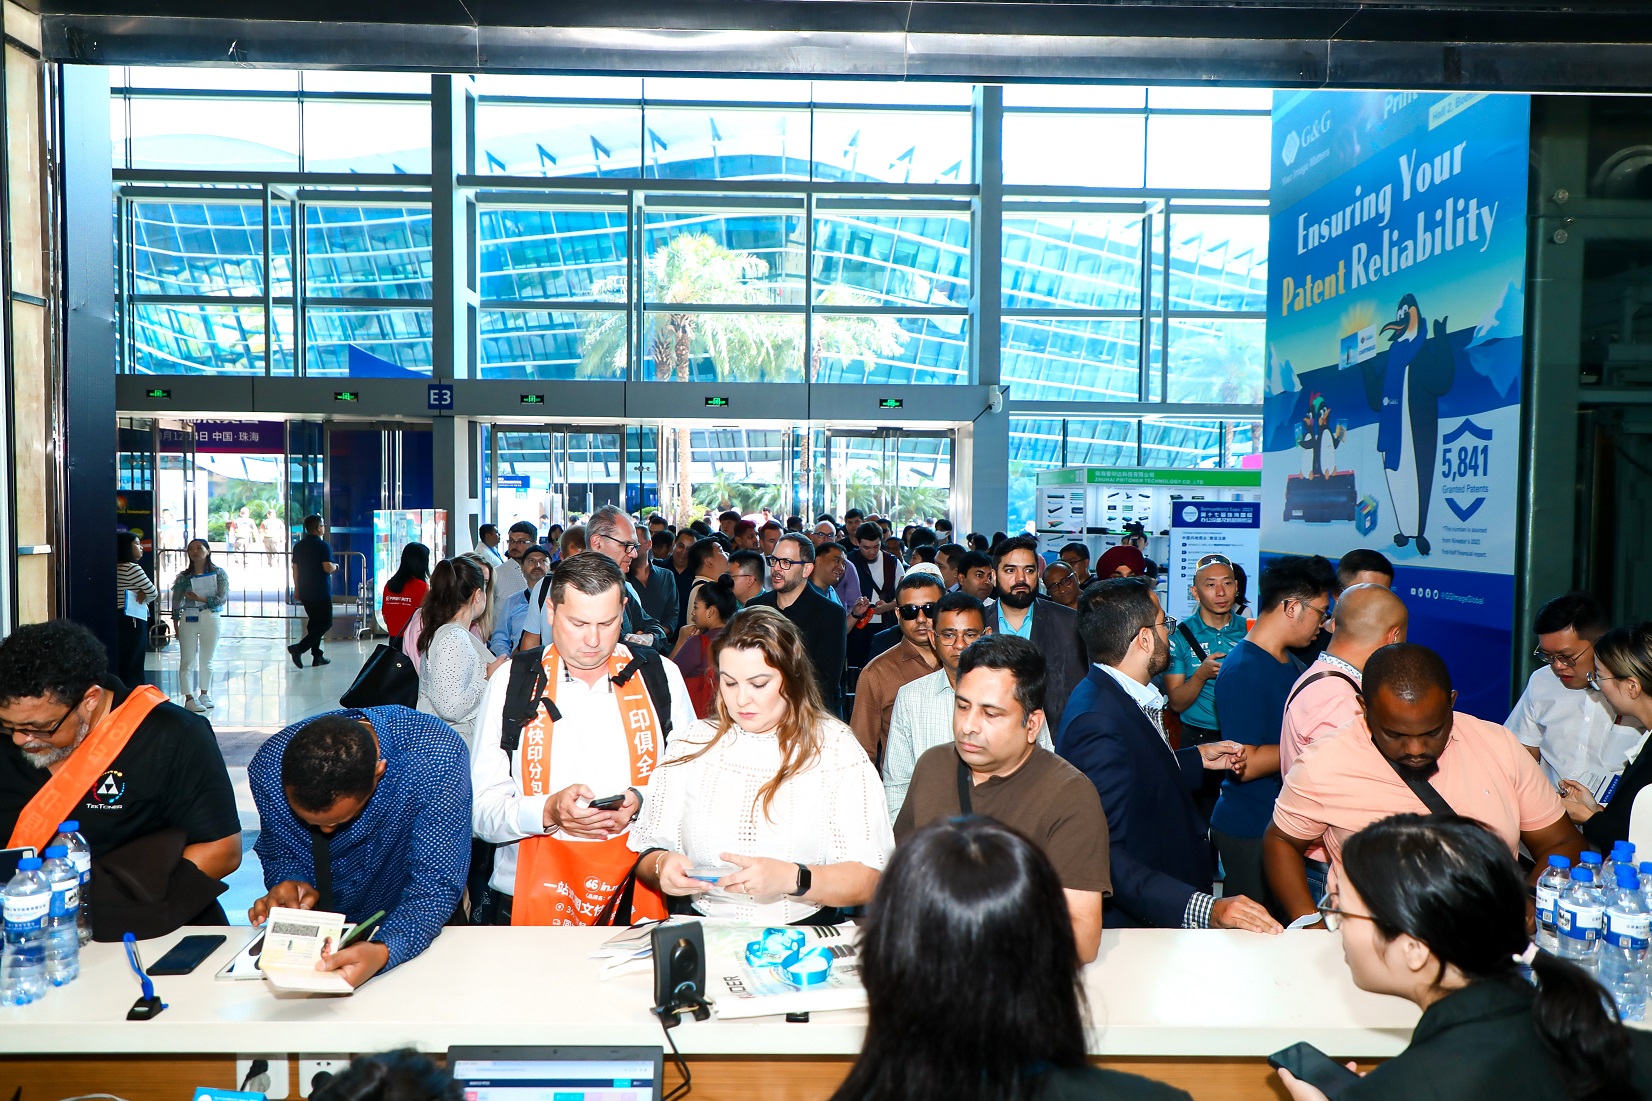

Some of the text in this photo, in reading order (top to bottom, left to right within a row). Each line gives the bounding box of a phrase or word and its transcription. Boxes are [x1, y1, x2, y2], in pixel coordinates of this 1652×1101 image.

[1301, 110, 1331, 148] G&G
[1297, 140, 1467, 255] Ensuring Your
[1281, 198, 1498, 317] Patent Reliability
[430, 390, 451, 404] E3
[1442, 445, 1488, 482] 5,841
[1442, 484, 1488, 493] Granted Patents
